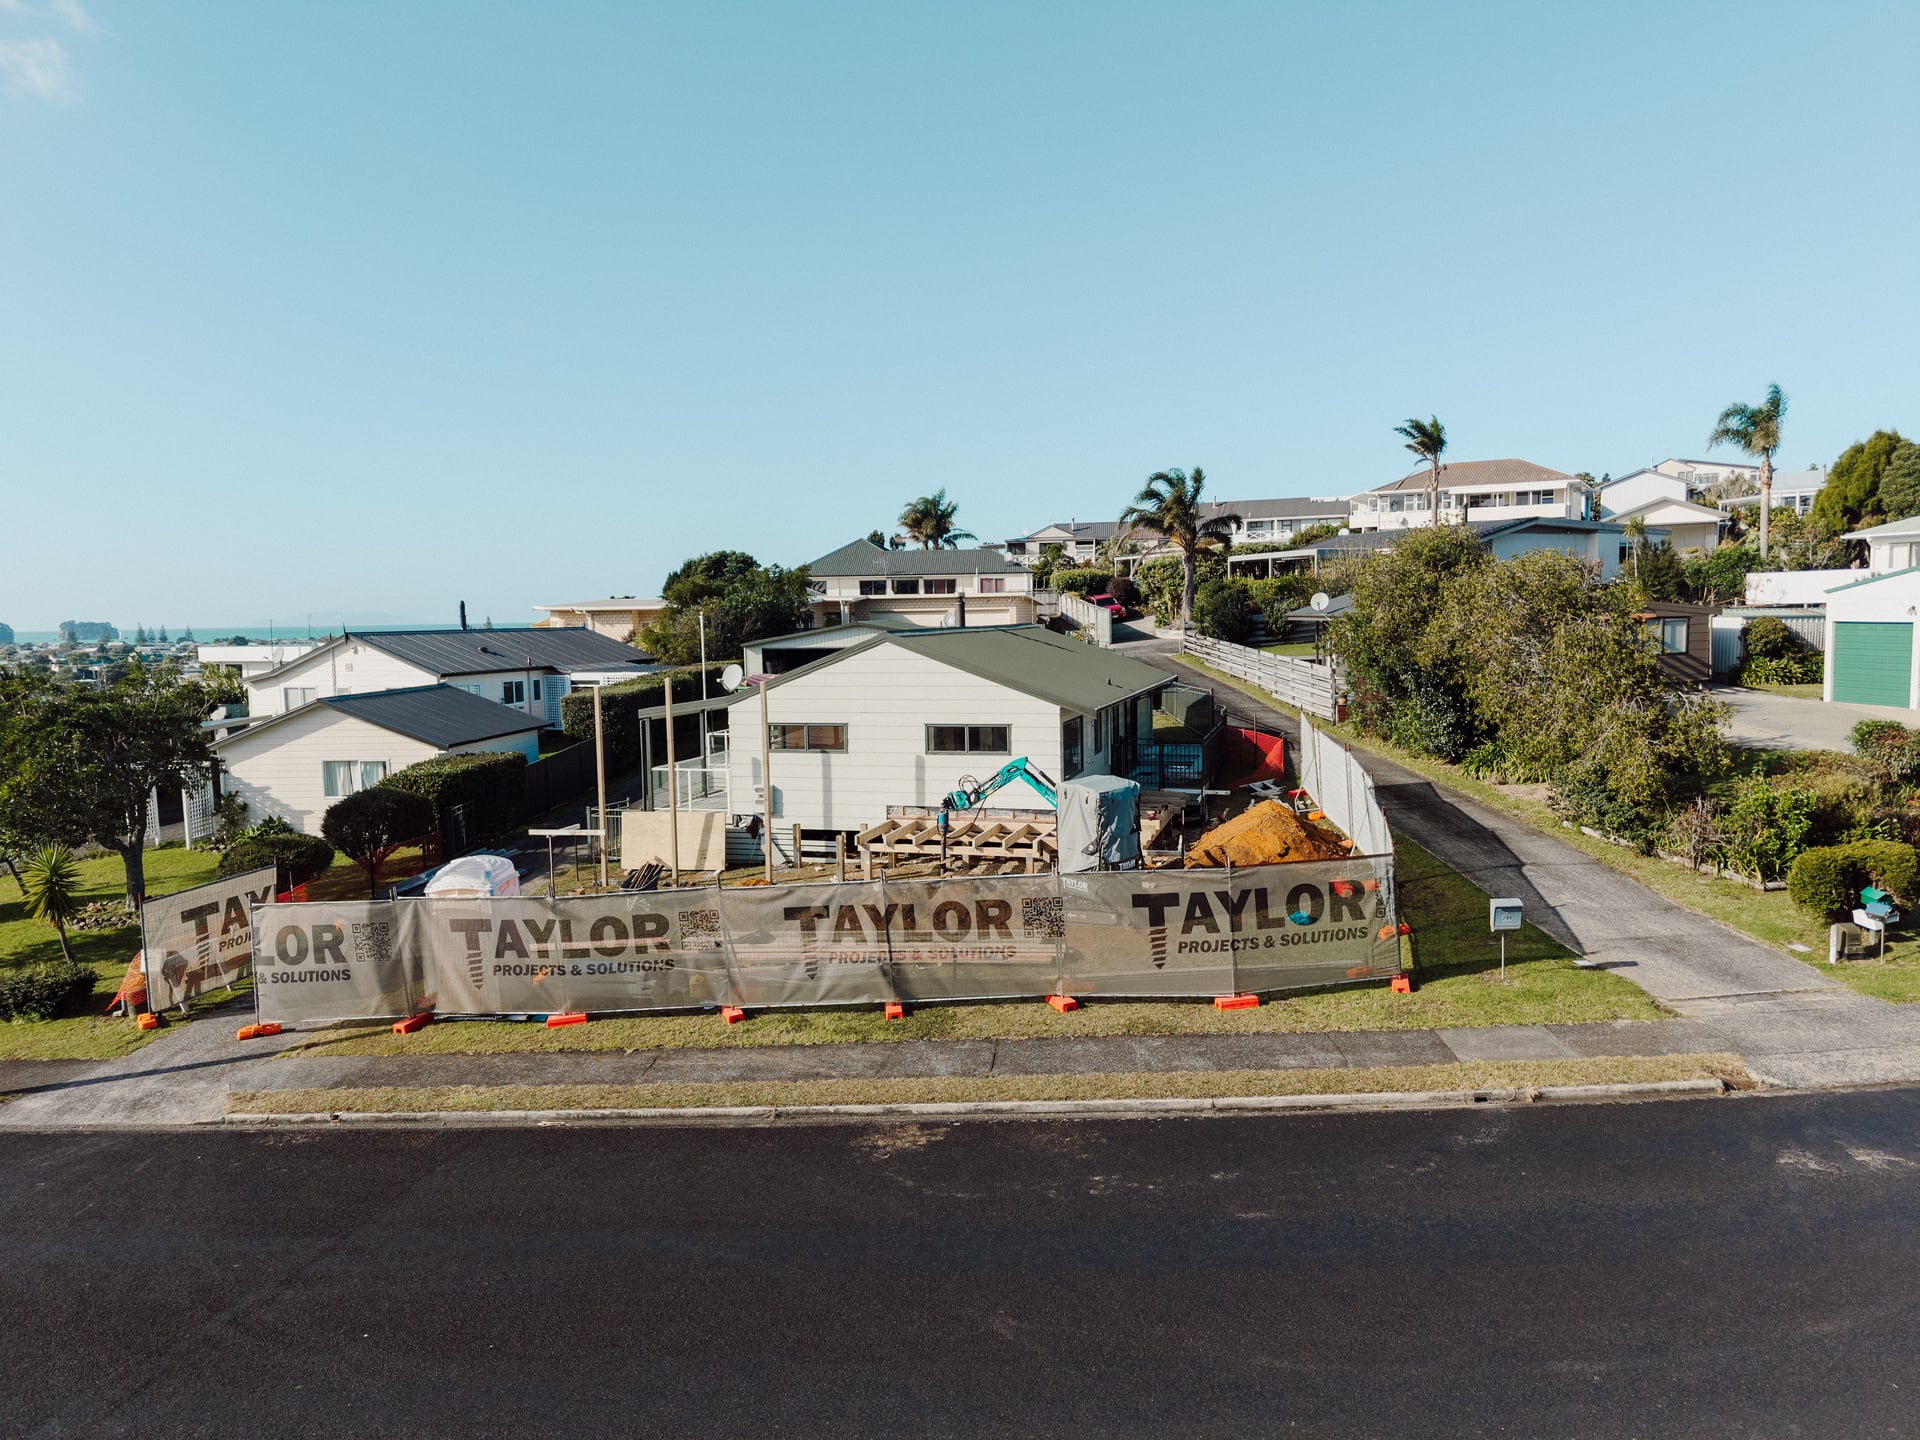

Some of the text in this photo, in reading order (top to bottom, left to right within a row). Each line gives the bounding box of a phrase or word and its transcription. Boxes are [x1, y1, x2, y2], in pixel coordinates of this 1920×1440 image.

[783, 899, 1014, 943] TAYLOR
[1131, 880, 1367, 935] TAYLOR
[449, 913, 672, 959] TAYLOR
[1177, 926, 1369, 954] PROJECTS & SOLUTIONS
[493, 958, 675, 977] PROJECTS & SOLUTIONS
[828, 950, 907, 964] PROJECTS
[927, 945, 1017, 961] SOLUTIONS
[258, 968, 351, 984] & SOLUTIONS
